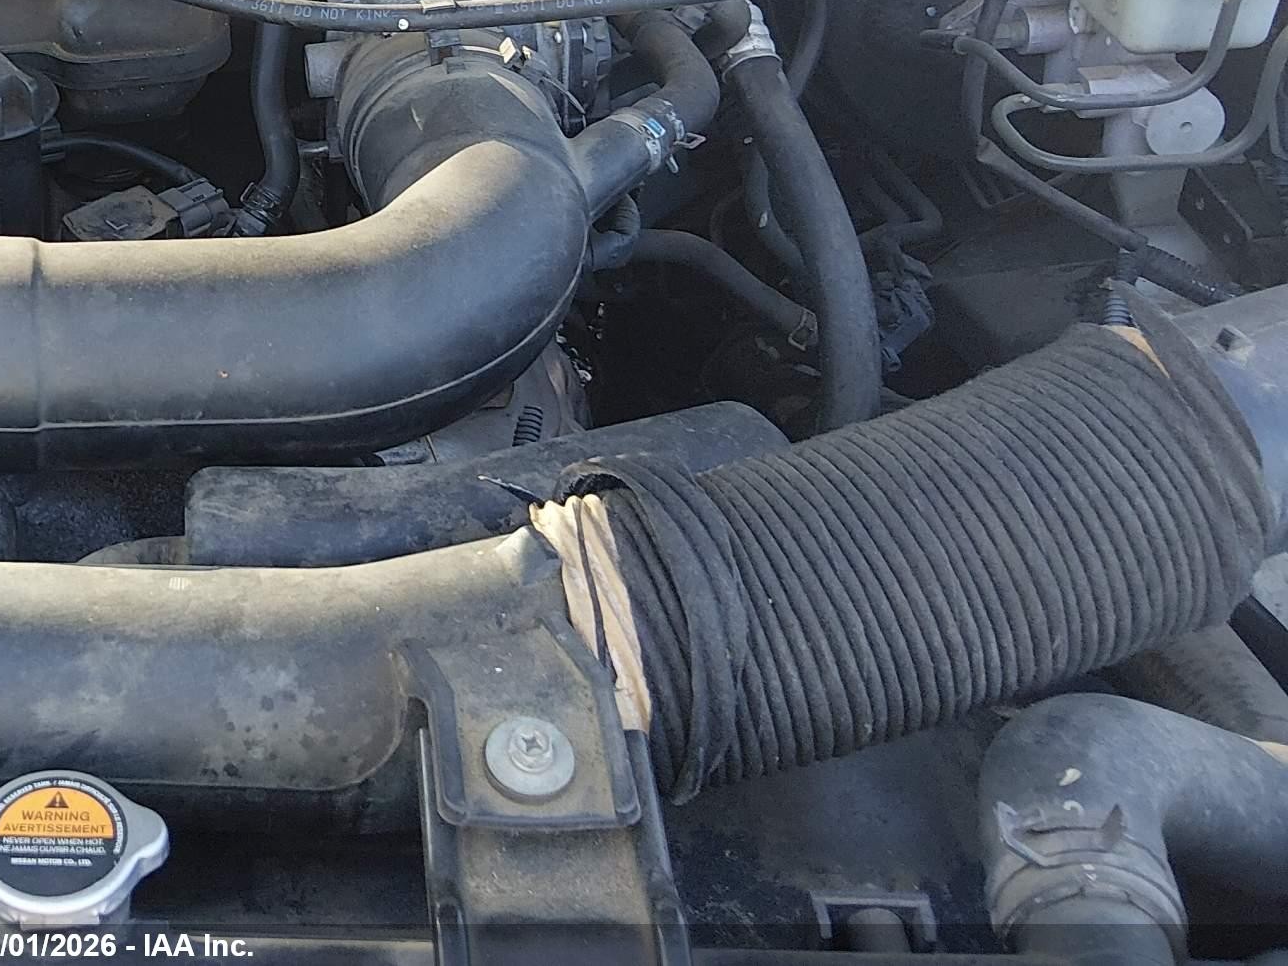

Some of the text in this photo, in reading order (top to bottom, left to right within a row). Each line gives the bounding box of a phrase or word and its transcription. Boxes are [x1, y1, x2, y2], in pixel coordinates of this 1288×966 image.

[294, 6, 313, 18] DO
[320, 8, 346, 20] NOT
[22, 810, 91, 822] WARNING
[3, 822, 107, 834] AVERTISSEMENT
[2, 836, 31, 844] NEVER
[32, 837, 56, 845] OPEN
[57, 838, 83, 846] WHEN
[11, 857, 37, 866] NISSAN
